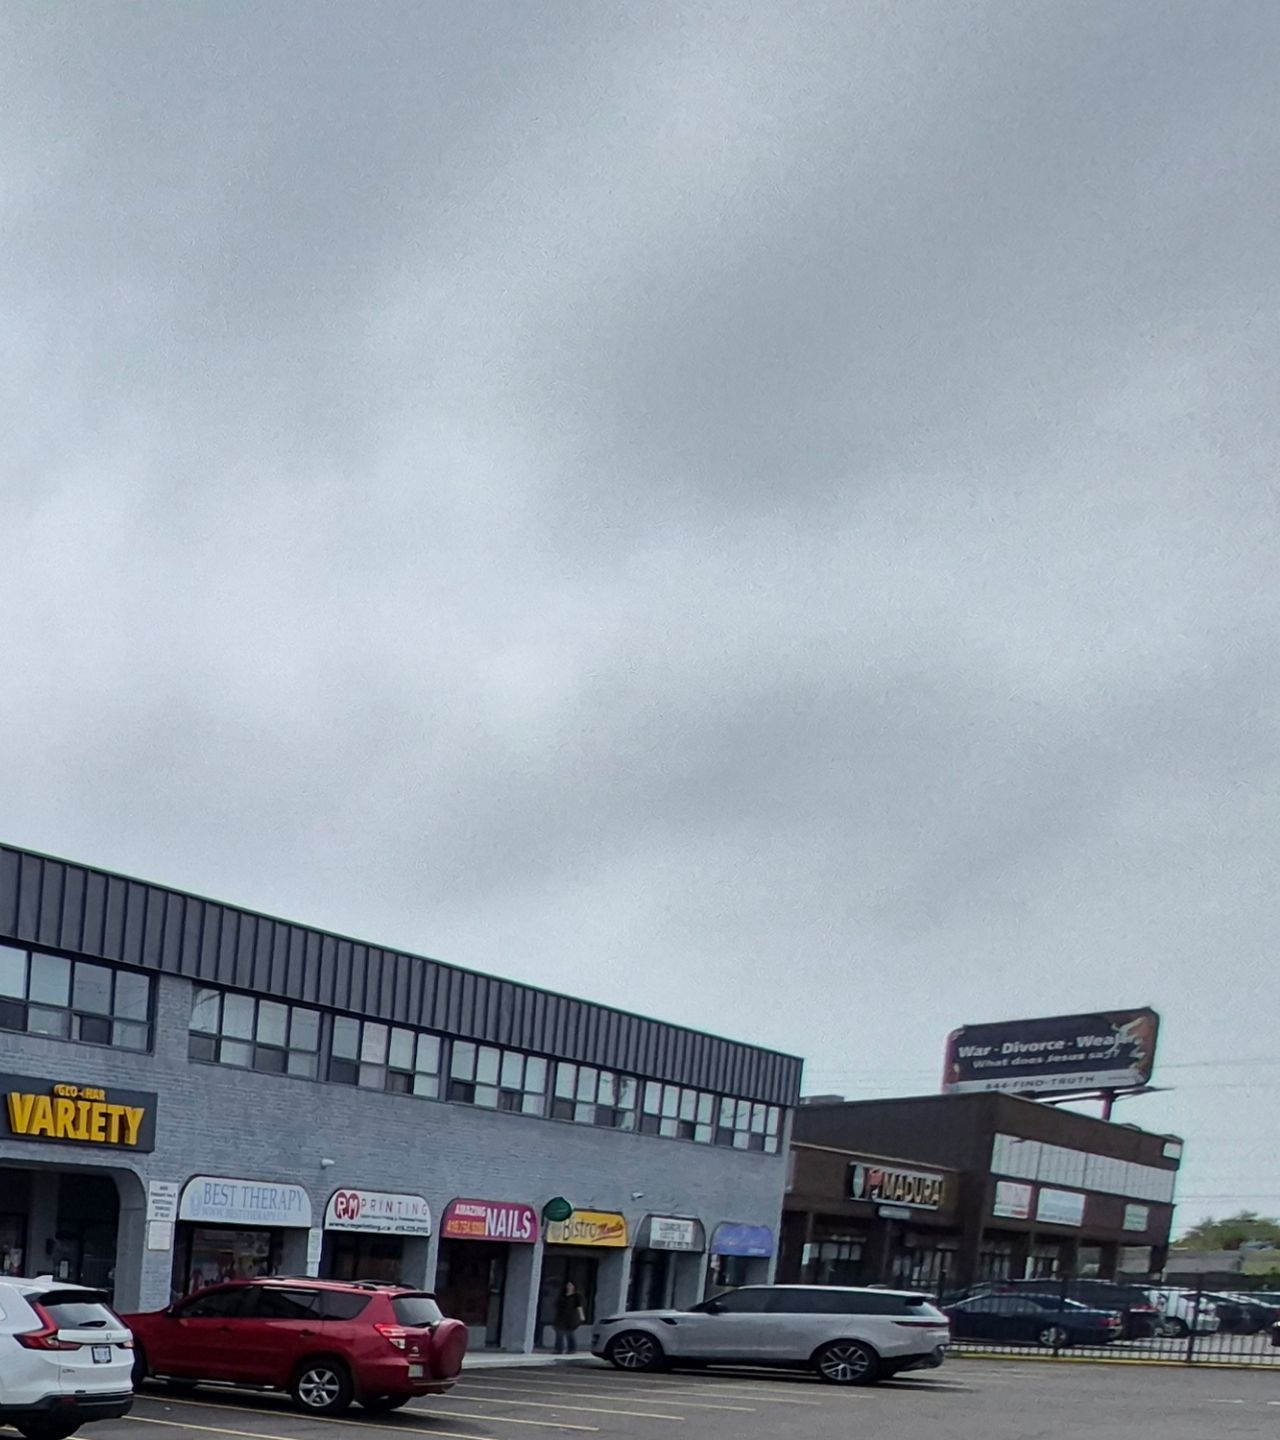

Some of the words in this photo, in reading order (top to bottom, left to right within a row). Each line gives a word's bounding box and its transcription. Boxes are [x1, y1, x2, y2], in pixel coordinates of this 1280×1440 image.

[958, 1045, 992, 1057] War
[1001, 1040, 1066, 1054] Divorce
[973, 1058, 1010, 1069] What
[1011, 1055, 1045, 1066] does
[1046, 1052, 1086, 1063] Jesus
[6, 1091, 145, 1146] VARIETY
[203, 1182, 238, 1207] BEST
[242, 1185, 305, 1212] THERAPY
[361, 1198, 428, 1217] PRINTING
[484, 1207, 532, 1240] NAILS
[562, 1218, 598, 1241] Bistro
